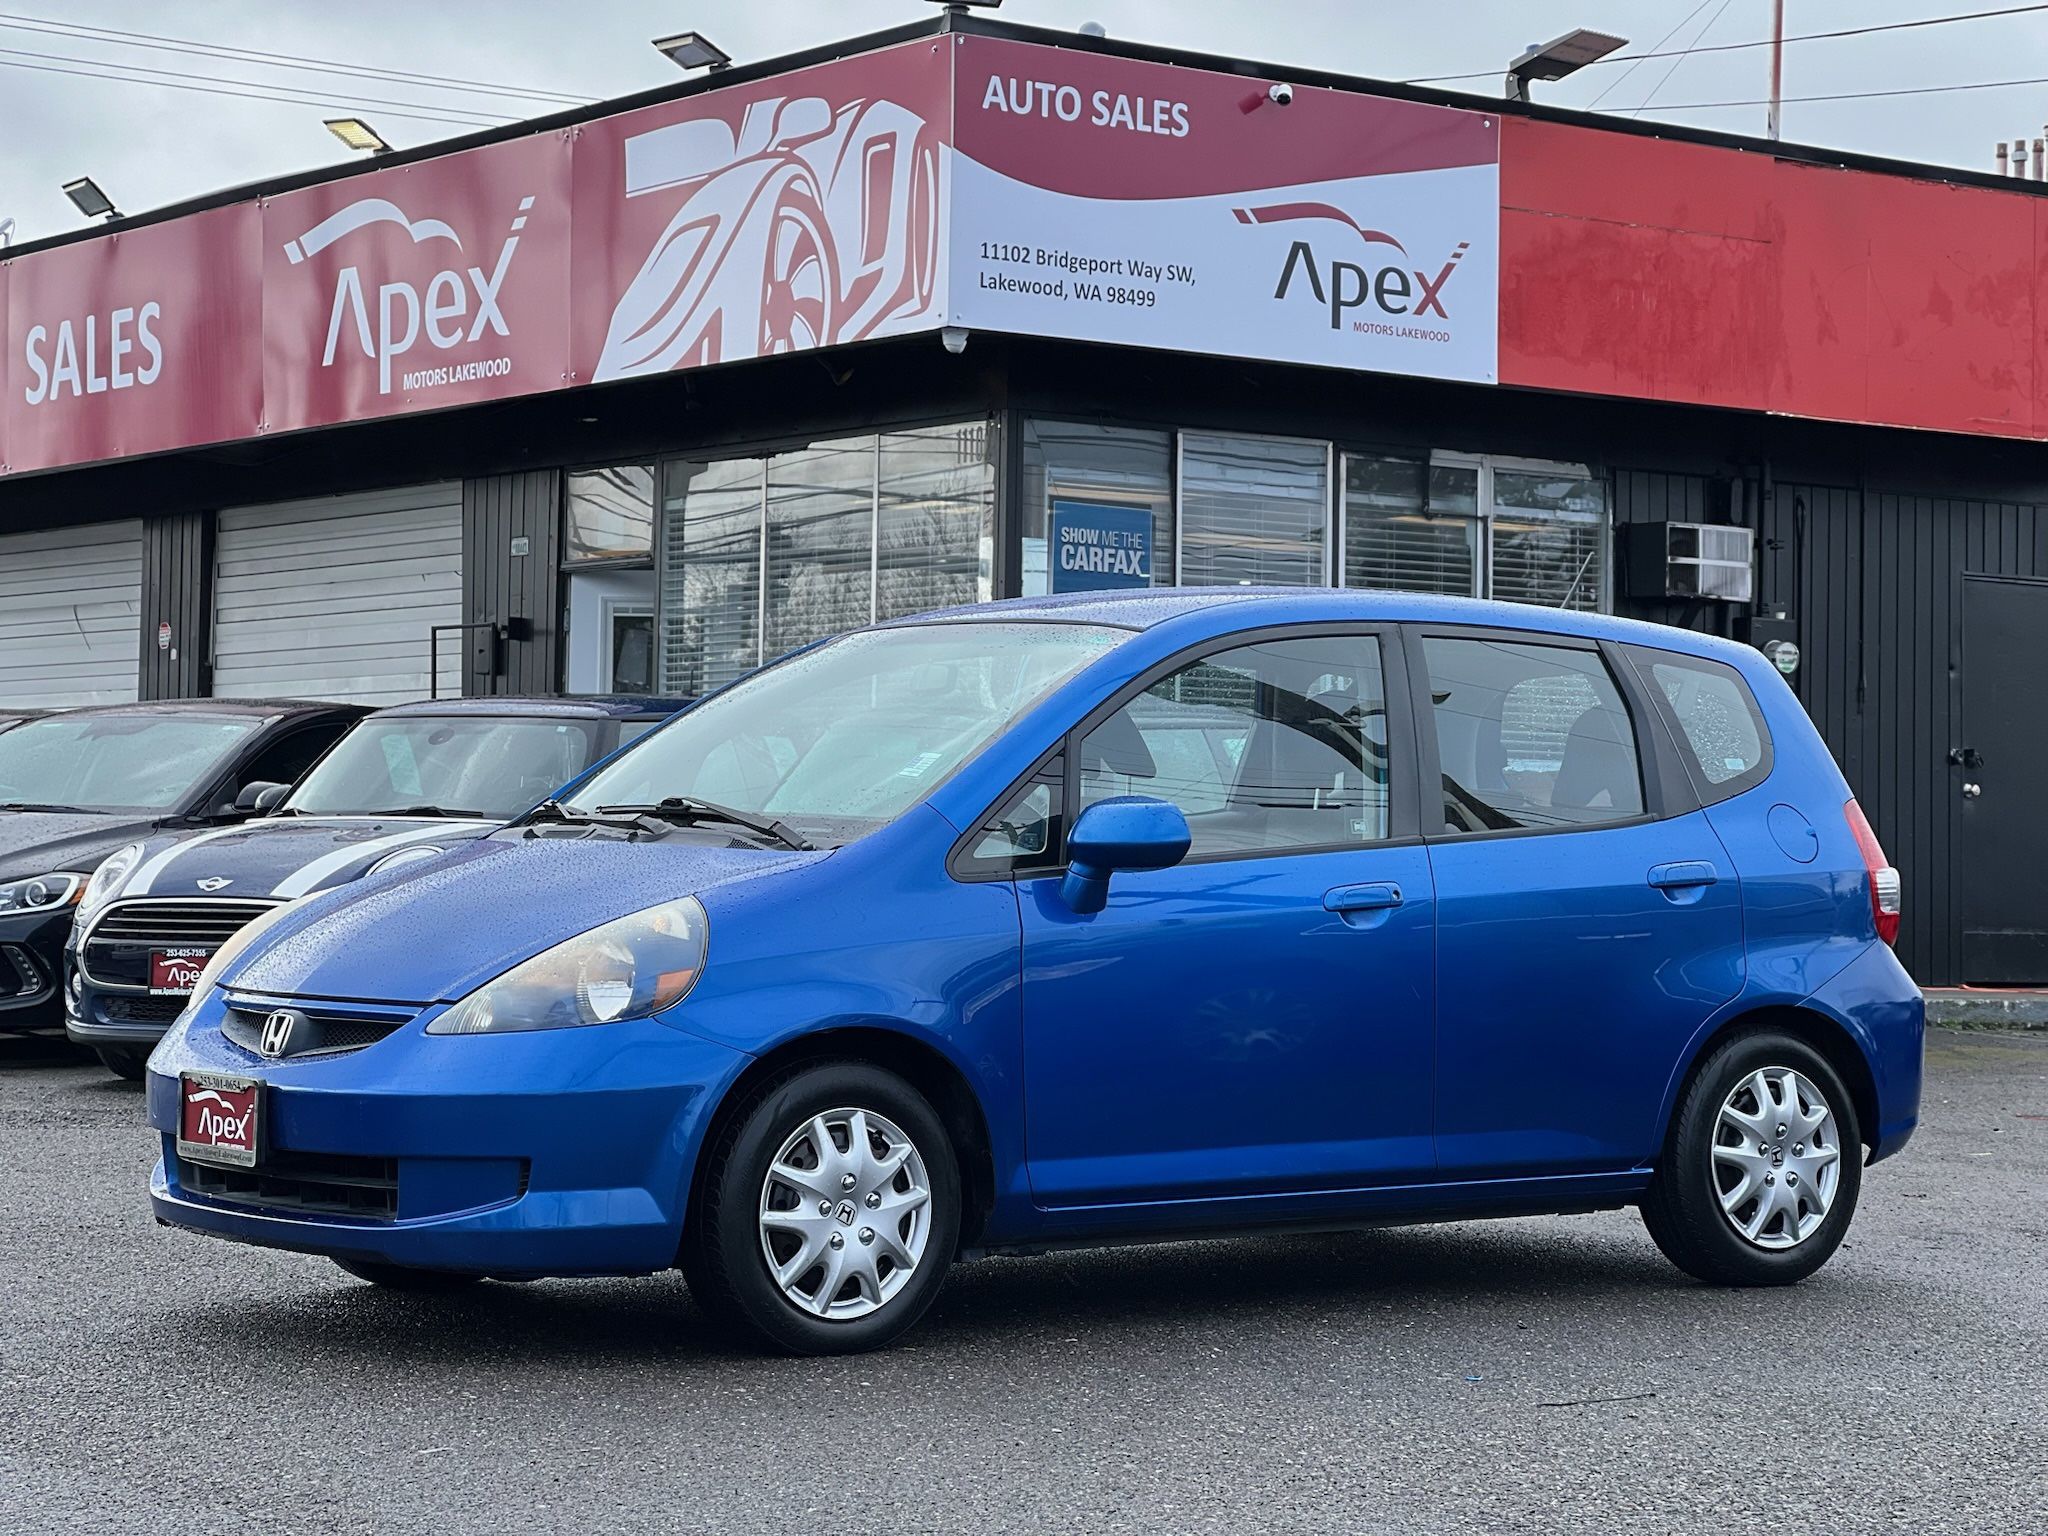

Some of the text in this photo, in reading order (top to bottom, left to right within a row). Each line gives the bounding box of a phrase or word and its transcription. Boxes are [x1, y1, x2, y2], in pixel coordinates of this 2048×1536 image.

[982, 75, 1190, 137] AUTO SALES
[980, 241, 1196, 286] 11102 Bridgeport Way SW,
[322, 196, 535, 394] Apex
[980, 271, 1156, 307] Lakewood, WA 98499
[1274, 241, 1470, 330] Apex
[1353, 321, 1450, 343] MOTORS LAKEWOOD
[25, 301, 162, 405] SALES
[403, 357, 511, 390] MOTORS LAKEWOOD
[1061, 526, 1144, 549] SHOW ME THE
[1060, 544, 1142, 576] CARFAX
[167, 967, 203, 986] Ape
[198, 1104, 254, 1146] Apex
